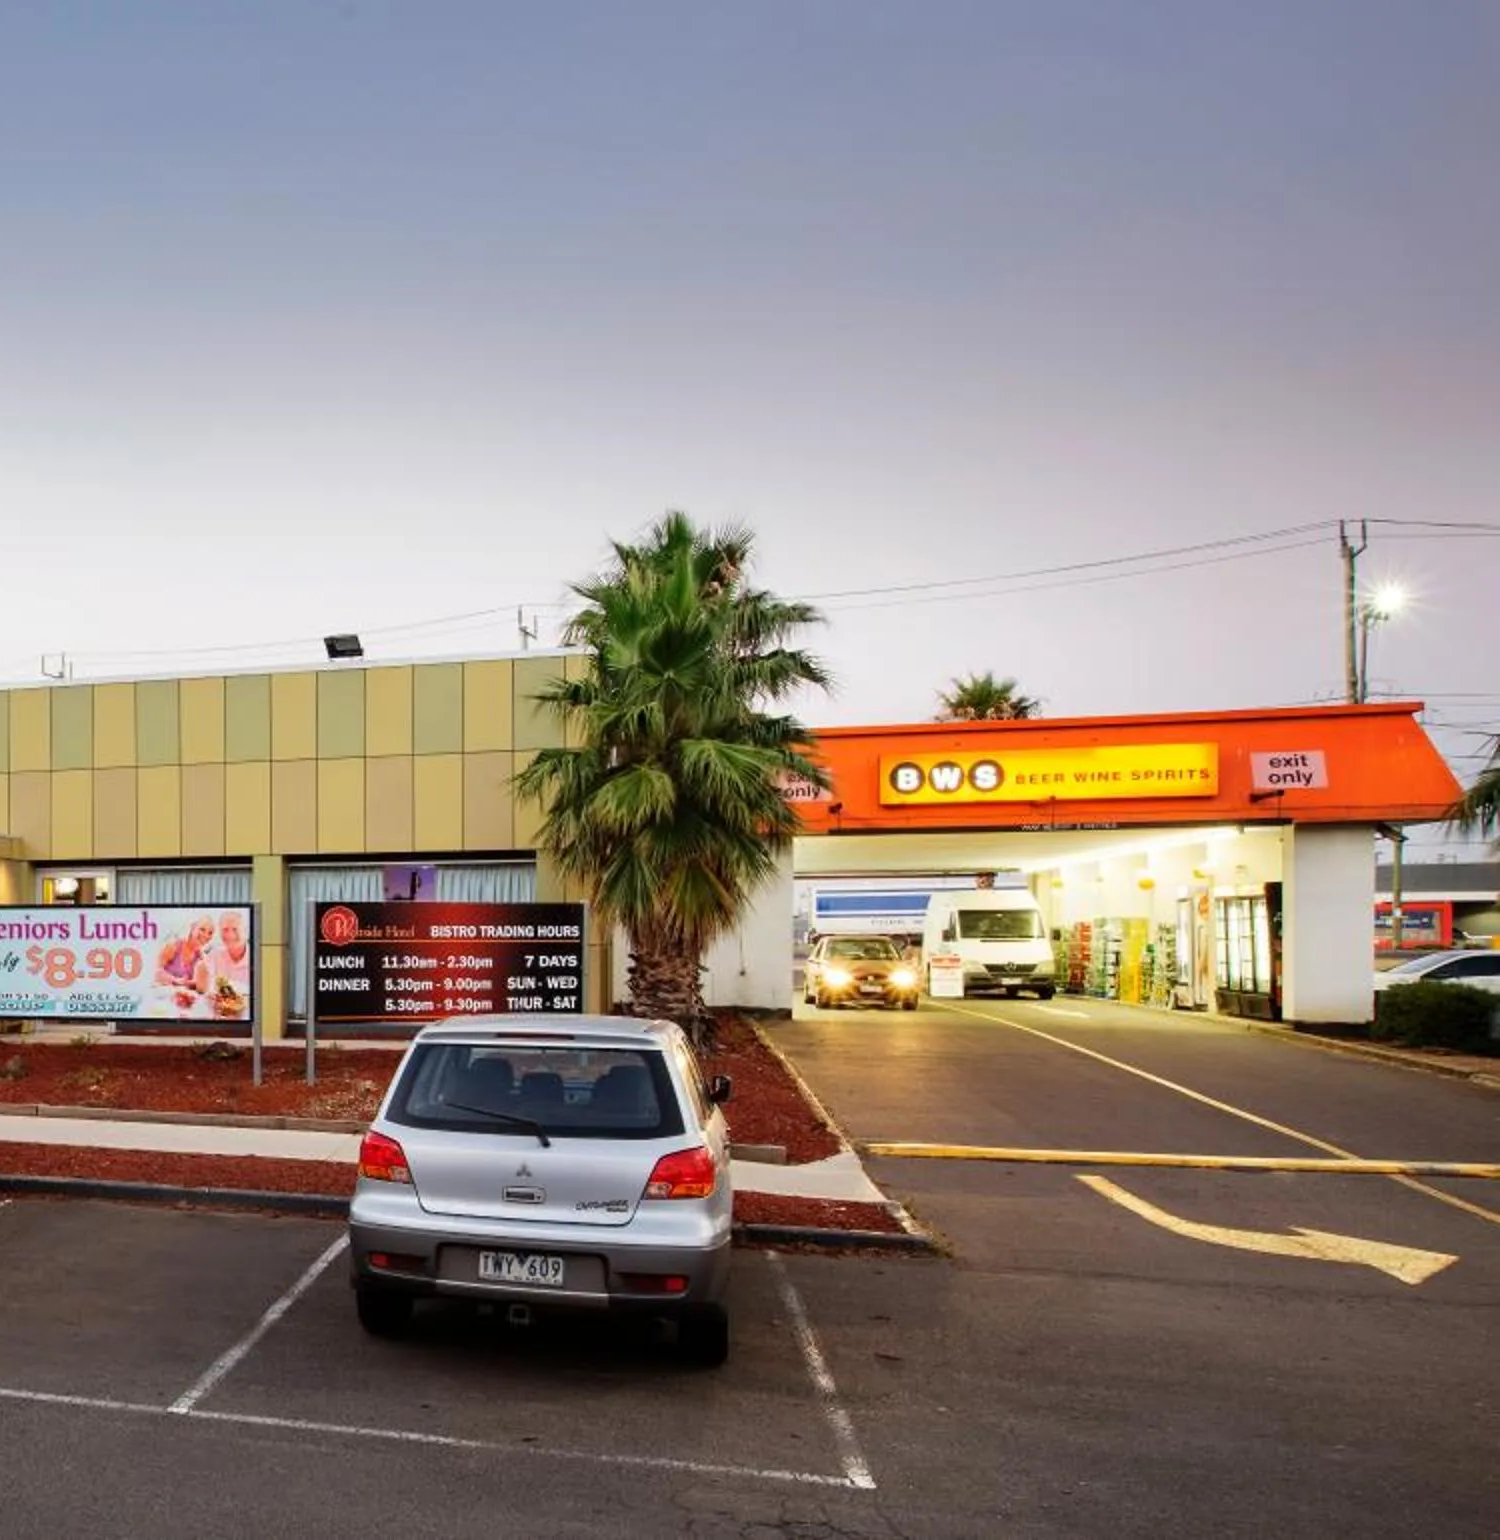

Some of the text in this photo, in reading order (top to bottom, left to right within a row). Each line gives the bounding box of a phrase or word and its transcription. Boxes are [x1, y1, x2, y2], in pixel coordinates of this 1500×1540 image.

[1269, 754, 1308, 768] exit
[1015, 768, 1210, 785] BEER WINE SPIRITS
[1267, 770, 1313, 787] only
[783, 784, 821, 799] only
[79, 911, 157, 940] Lunch
[430, 925, 580, 937] BISTRO TRADING HOURS
[25, 945, 143, 989] $8.90
[318, 955, 365, 969] LUNCH
[382, 955, 437, 969] 11.30am
[447, 955, 493, 970] 2.30pm
[524, 955, 534, 968] 7
[539, 955, 578, 968] DAYS
[318, 978, 371, 991] DINNER
[385, 978, 433, 993] 5.30pm
[443, 977, 493, 992] 9.00pm
[507, 976, 536, 990] SUN
[547, 976, 578, 989] WED
[385, 998, 434, 1013] 5.30pm
[444, 997, 493, 1012] 9.30pm
[506, 996, 542, 1010] THUR
[553, 996, 577, 1010] SAT
[528, 1258, 560, 1278] 609
